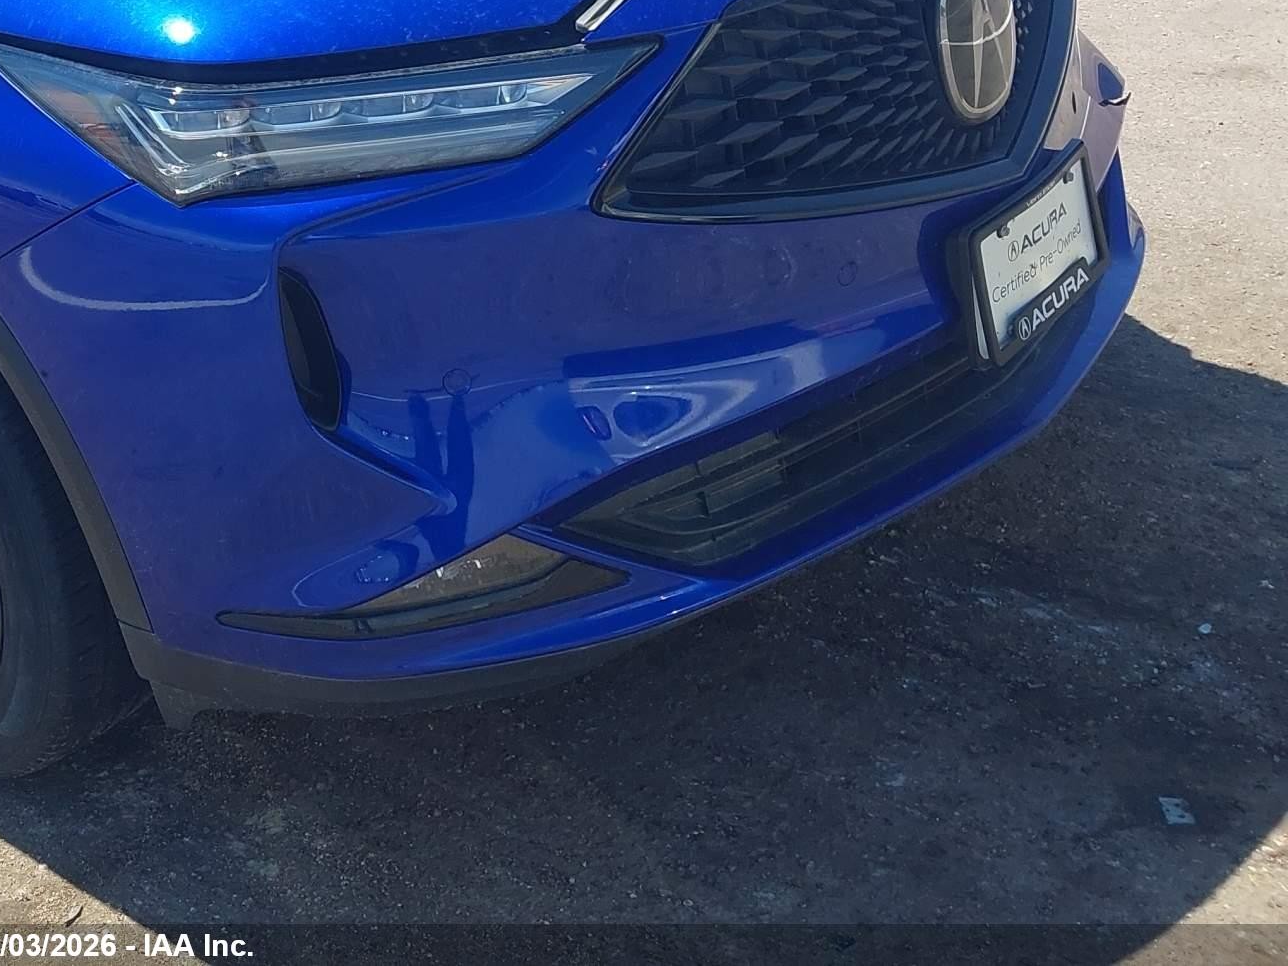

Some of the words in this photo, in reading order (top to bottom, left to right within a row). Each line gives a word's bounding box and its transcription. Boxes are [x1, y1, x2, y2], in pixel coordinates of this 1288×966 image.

[1020, 202, 1067, 254] ACURA
[992, 264, 1037, 304] Certified
[1039, 220, 1082, 267] Pre-Owned
[1031, 267, 1090, 332] ACURA
